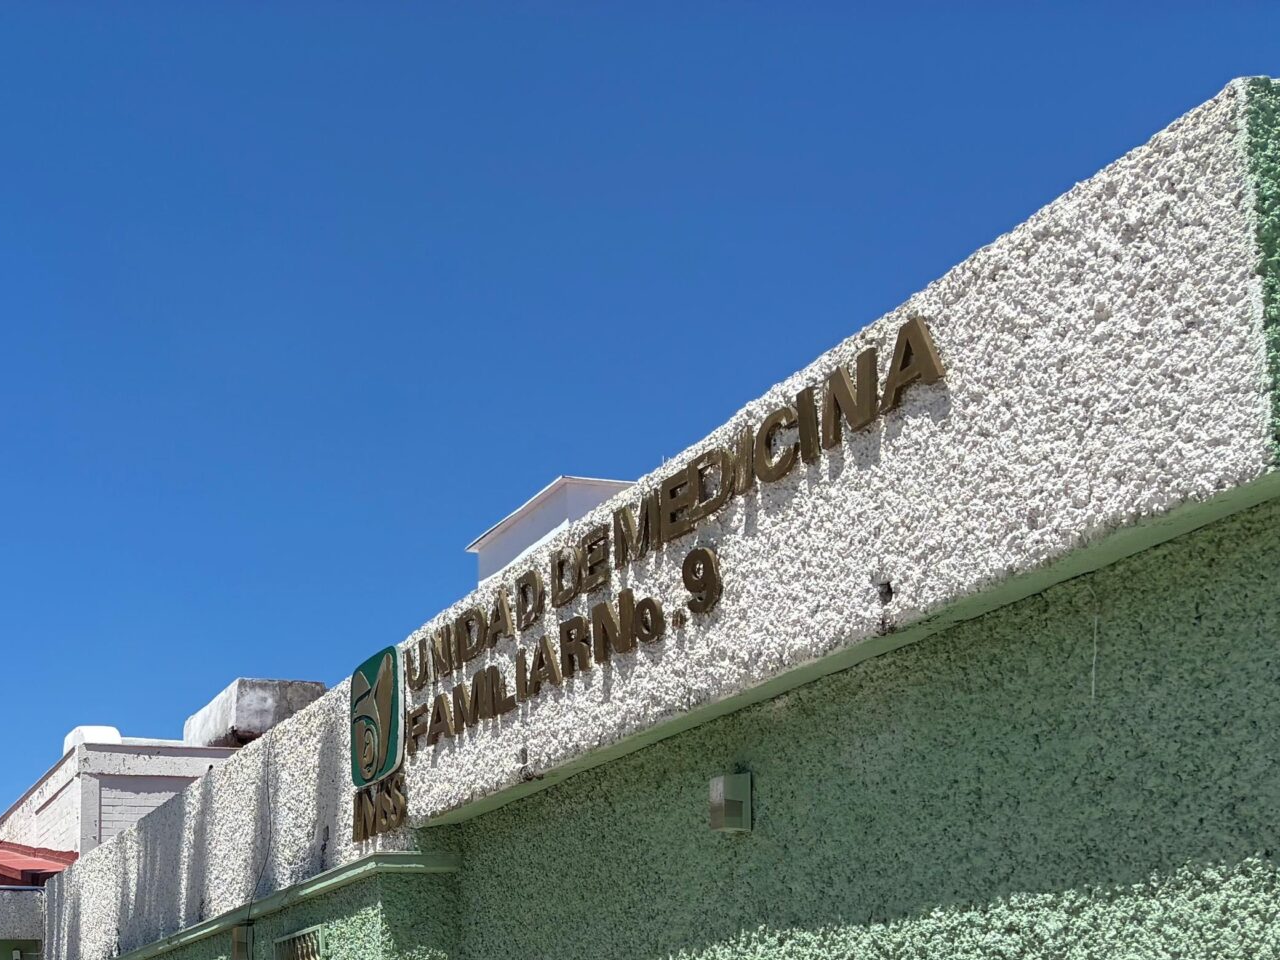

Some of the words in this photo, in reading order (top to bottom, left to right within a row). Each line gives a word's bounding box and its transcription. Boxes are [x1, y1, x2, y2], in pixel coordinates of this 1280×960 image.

[405, 569, 545, 691] UNIDAD
[551, 524, 610, 608] DE
[613, 316, 945, 570] MEDICINA
[406, 616, 594, 757] FAMILIAR
[682, 547, 724, 614] 9
